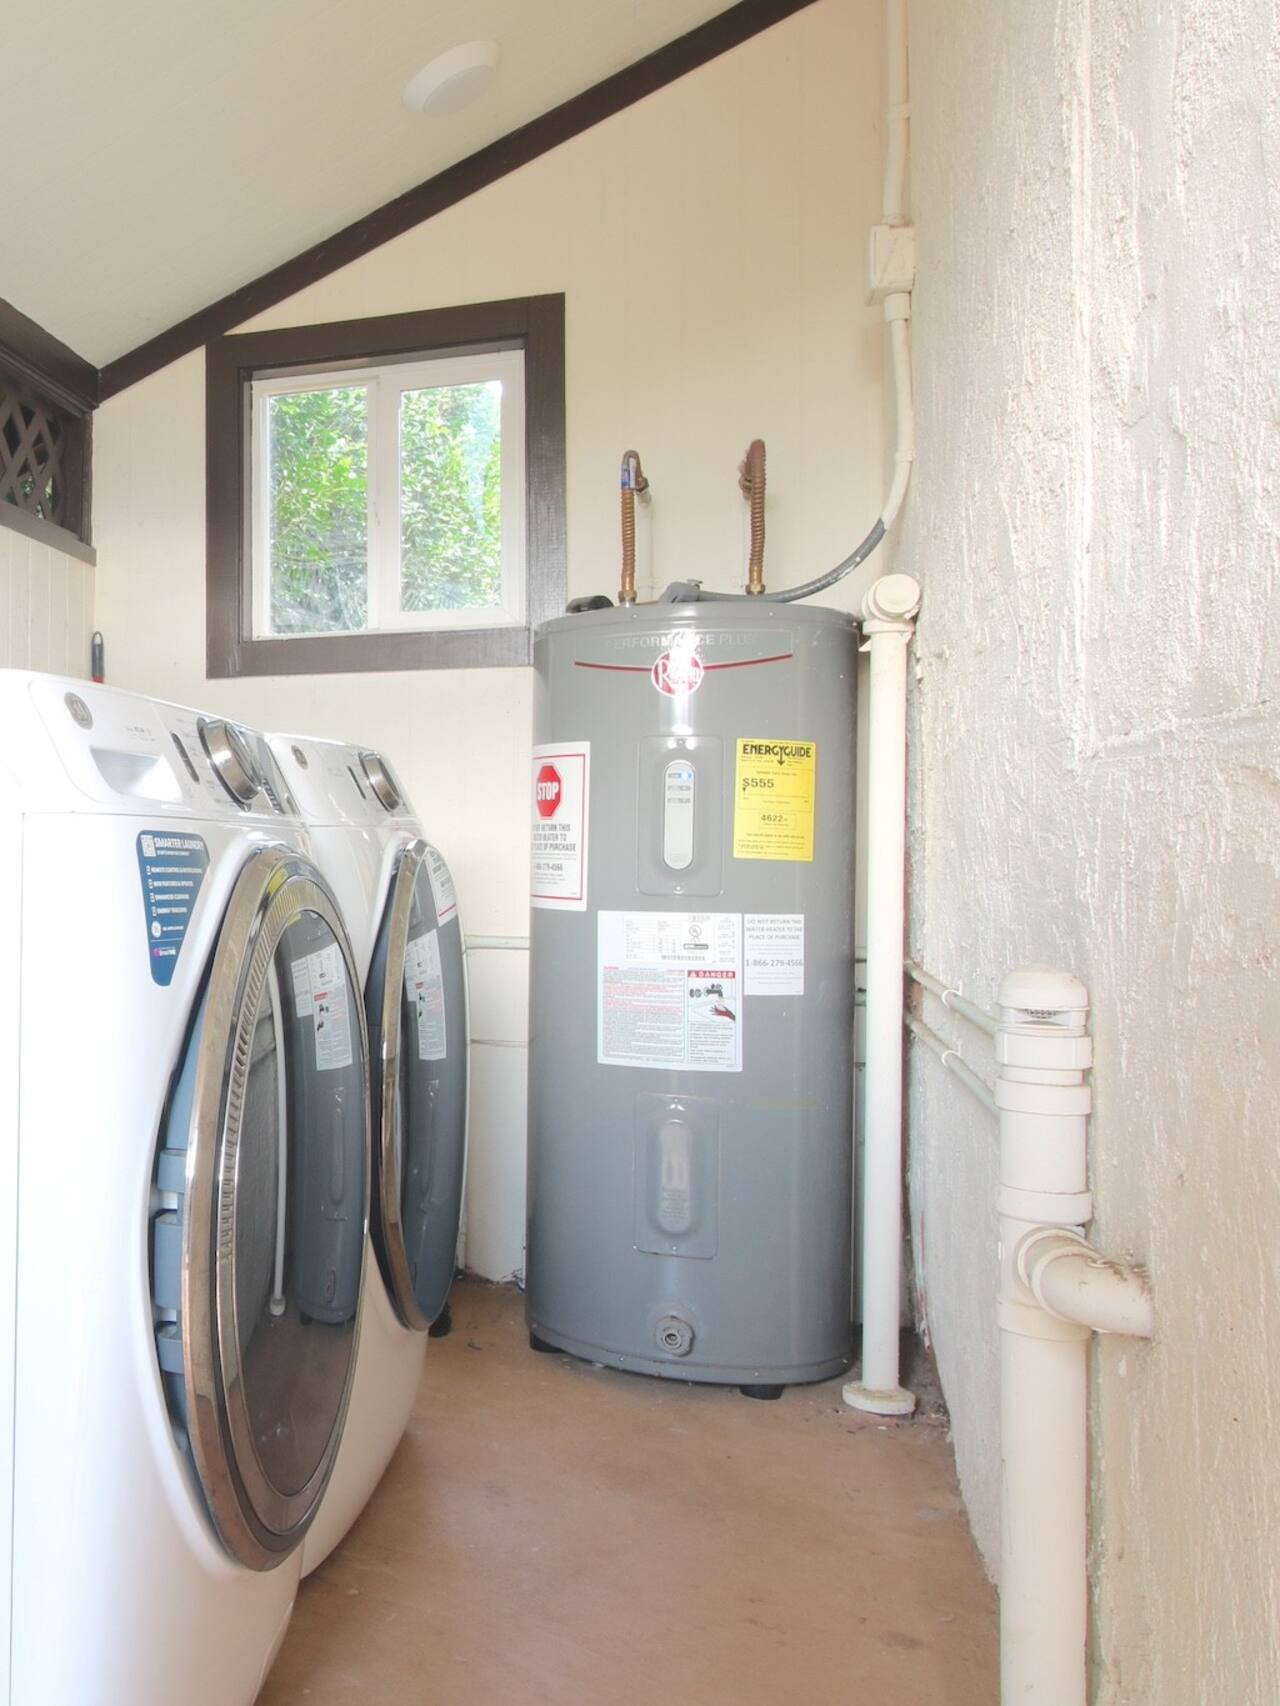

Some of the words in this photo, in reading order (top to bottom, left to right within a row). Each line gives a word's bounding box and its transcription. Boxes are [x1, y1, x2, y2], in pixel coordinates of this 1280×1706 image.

[742, 743, 812, 758] ENERGYGUIDE
[742, 777, 775, 789] $555
[537, 782, 560, 800] STOP
[559, 824, 571, 832] THIS
